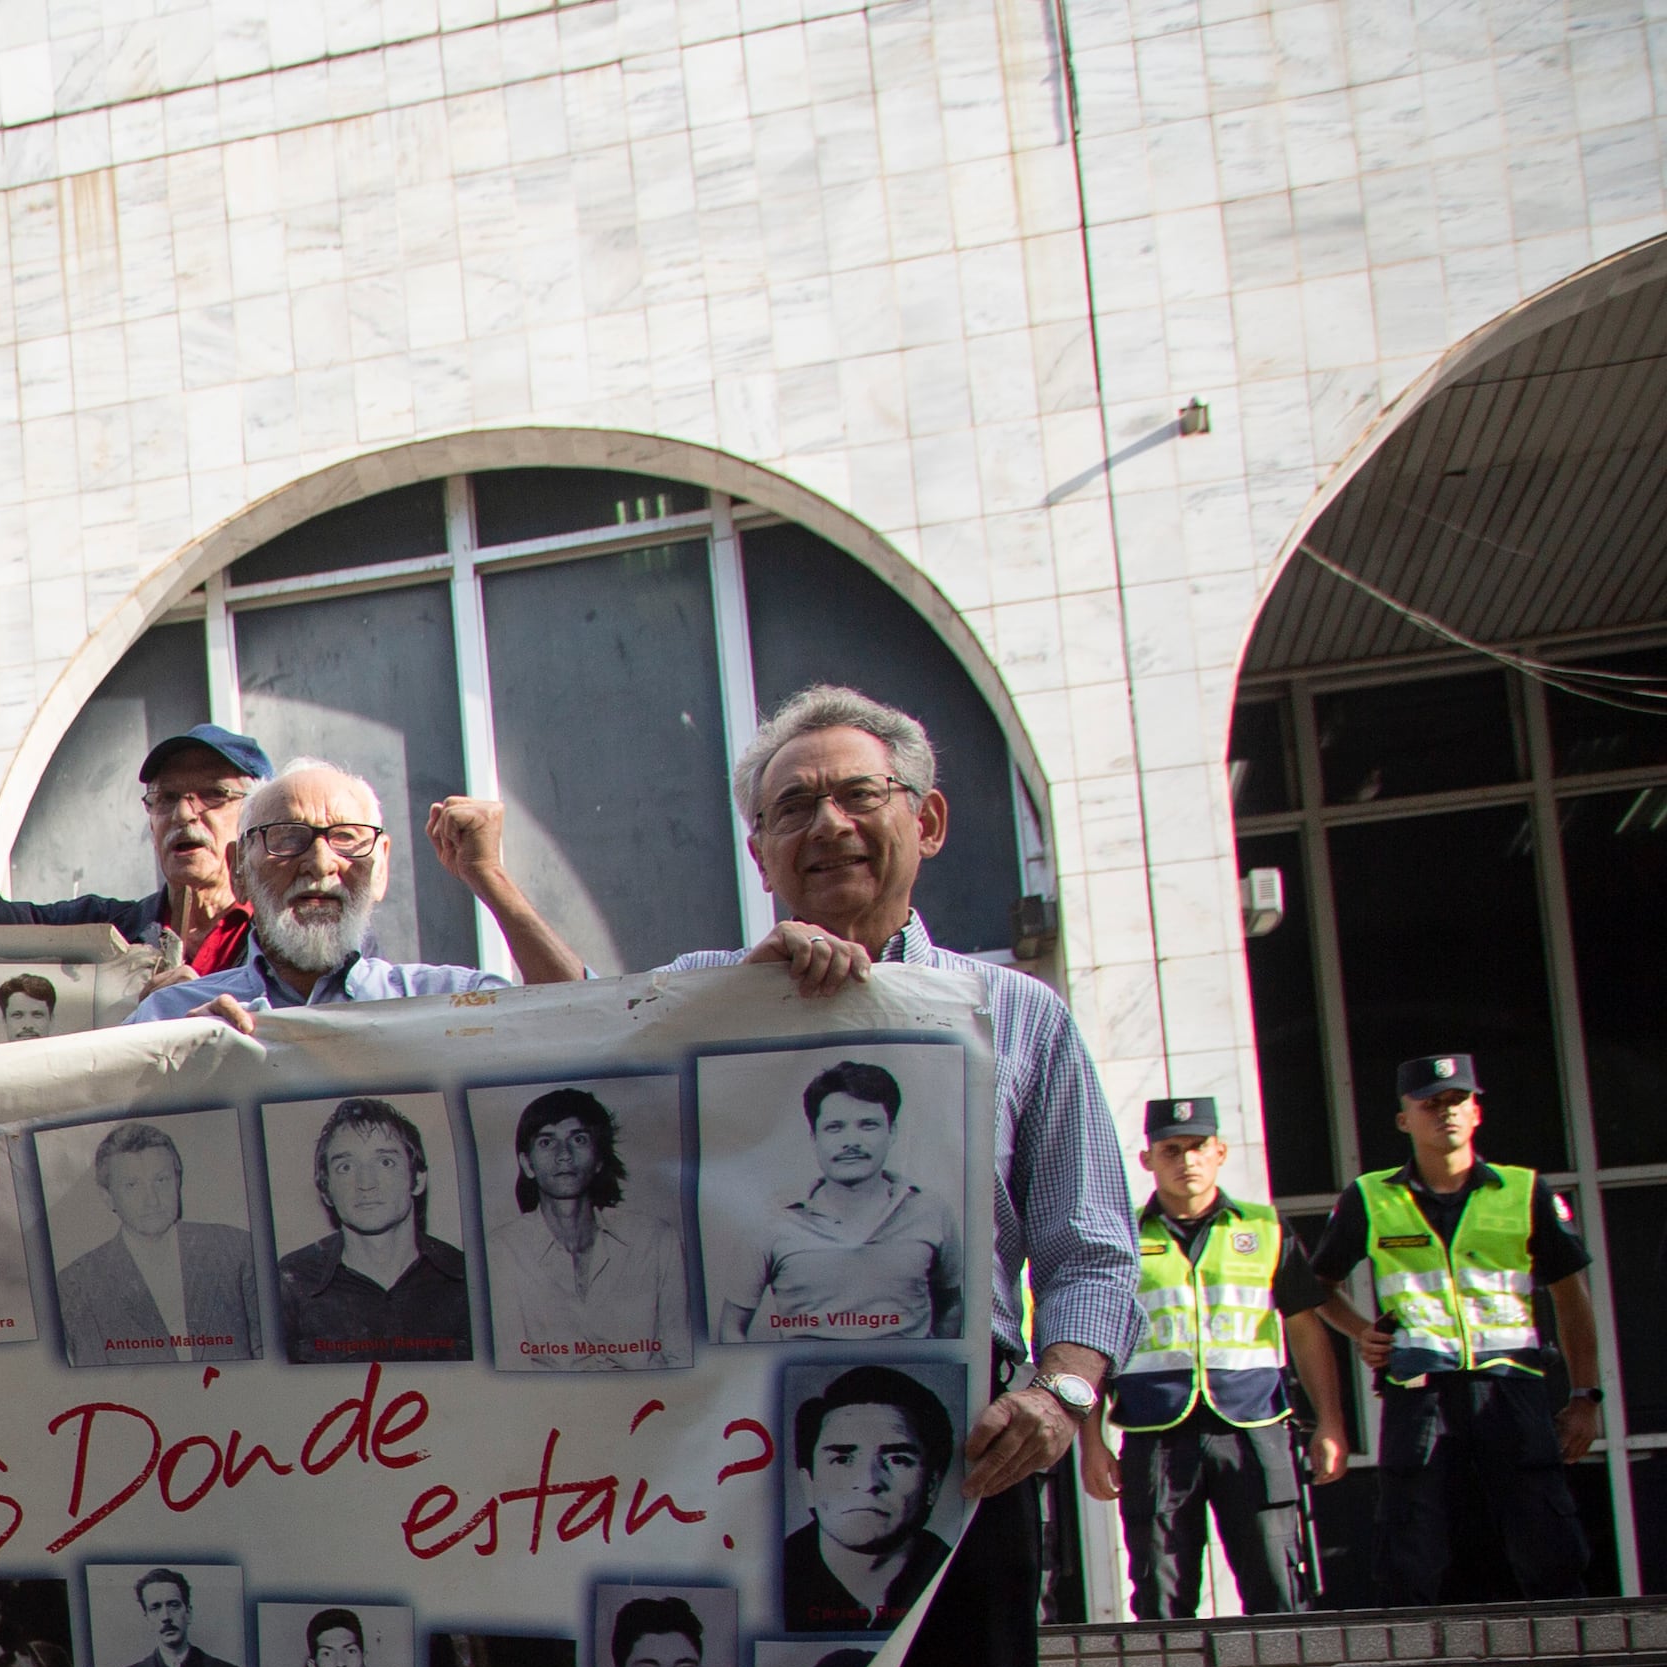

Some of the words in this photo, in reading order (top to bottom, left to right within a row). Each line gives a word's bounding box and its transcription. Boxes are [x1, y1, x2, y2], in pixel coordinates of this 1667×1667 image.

[770, 1313, 819, 1328] Derlis
[826, 1312, 900, 1329] Villagra
[1145, 1311, 1263, 1348] OLICIA
[105, 1336, 164, 1351] Antonio
[170, 1335, 234, 1348] Maidana
[519, 1341, 569, 1355] Carlos
[574, 1338, 662, 1355] Mancuello
[401, 1400, 775, 1560] están?
